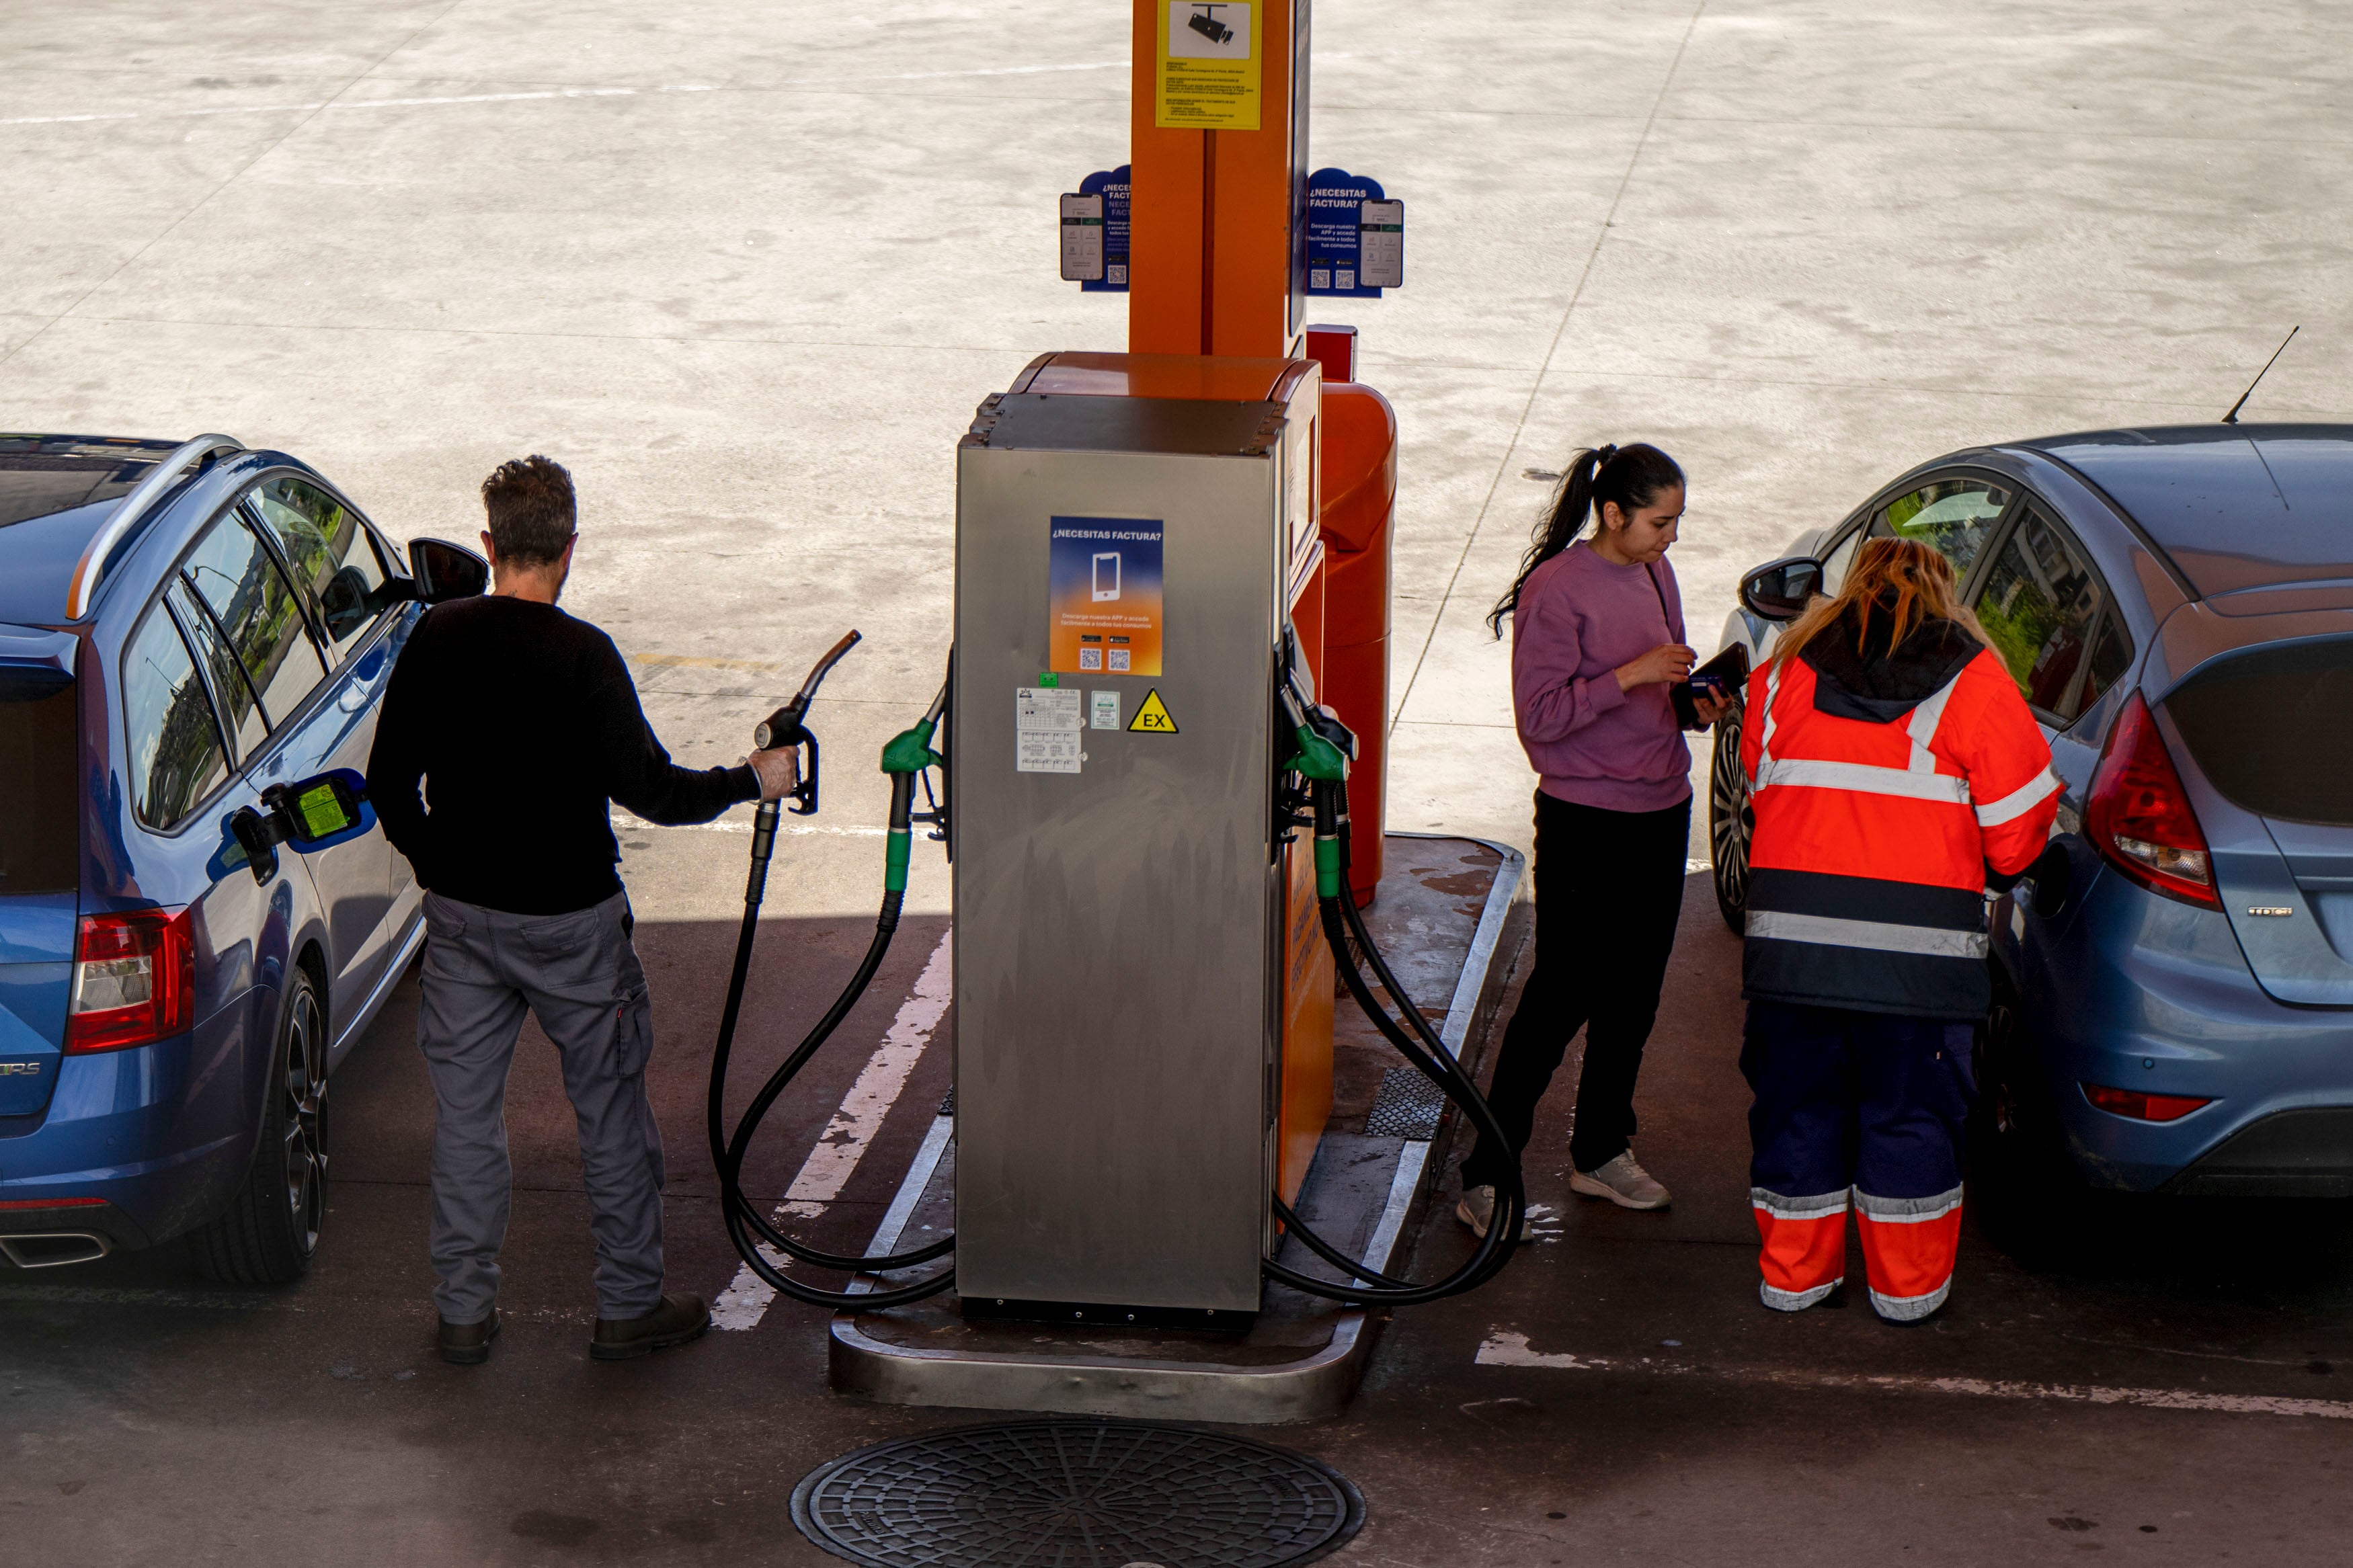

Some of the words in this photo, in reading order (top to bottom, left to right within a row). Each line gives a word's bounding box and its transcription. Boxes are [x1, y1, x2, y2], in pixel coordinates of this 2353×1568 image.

[1310, 188, 1367, 198] ¿NECESITAS
[1310, 199, 1358, 208] FACTURA?
[1053, 530, 1110, 539] ¿NECESITAS
[1112, 531, 1162, 541] FACTURA?
[1144, 713, 1166, 728] EX
